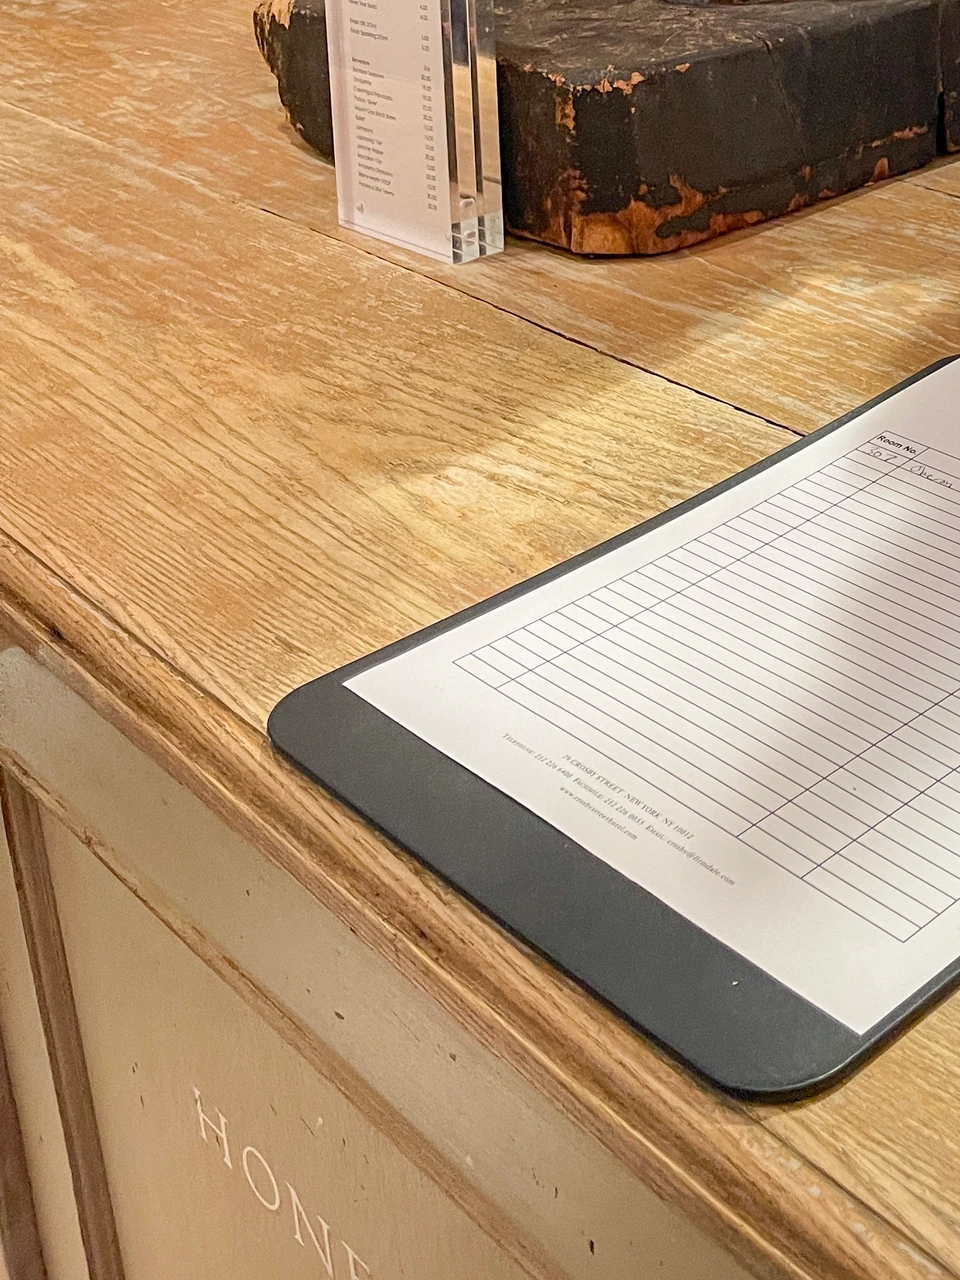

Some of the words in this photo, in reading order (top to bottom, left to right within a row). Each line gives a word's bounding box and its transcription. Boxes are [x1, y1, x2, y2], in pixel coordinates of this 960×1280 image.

[877, 435, 902, 448] Room
[903, 443, 918, 455] No.
[570, 759, 598, 777] CROSBY
[596, 775, 625, 794] STREET
[624, 793, 644, 806] NEW
[641, 803, 662, 819] YORK
[603, 798, 617, 808] 212
